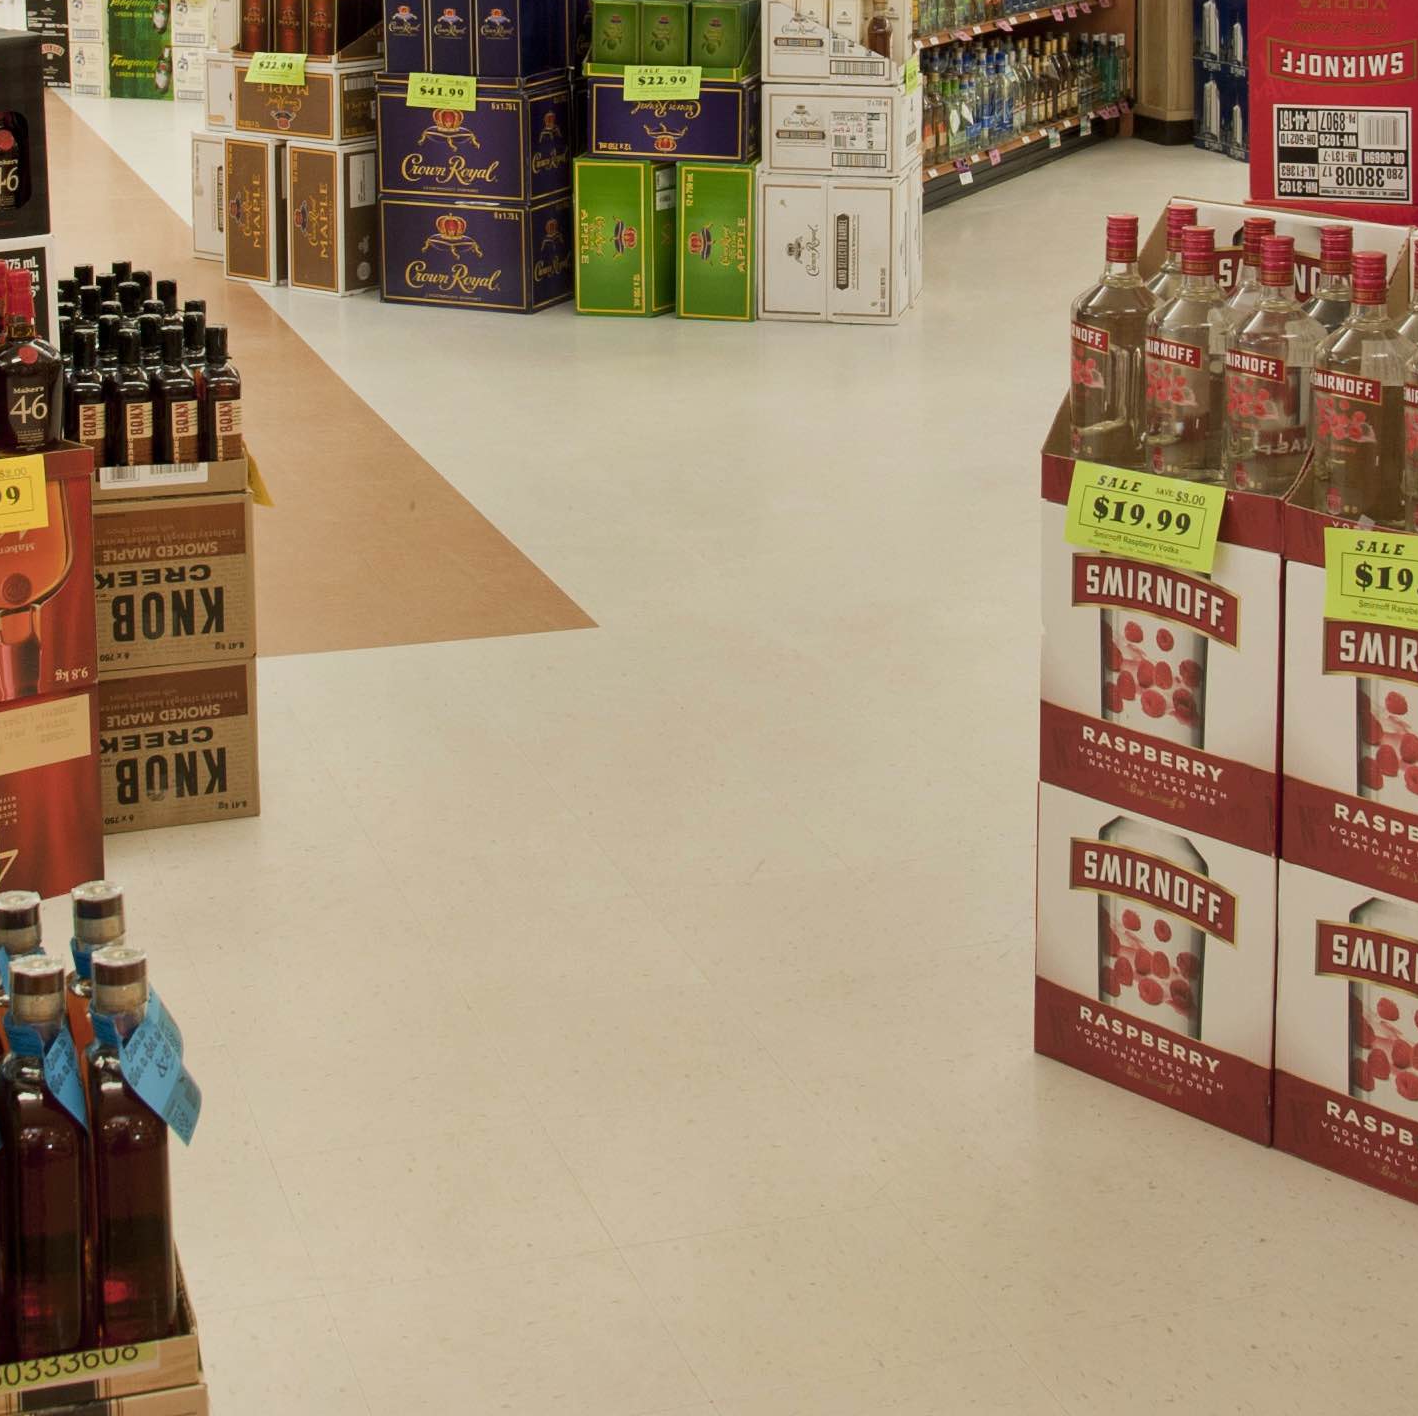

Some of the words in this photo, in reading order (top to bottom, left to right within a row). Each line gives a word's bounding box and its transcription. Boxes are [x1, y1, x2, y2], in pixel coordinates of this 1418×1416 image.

[637, 74, 687, 87] $22.99
[401, 153, 447, 183] Crown
[448, 153, 498, 184] Royal
[103, 545, 155, 563] MAPLE
[160, 542, 218, 560] SMOKED
[112, 587, 225, 642] KNOB
